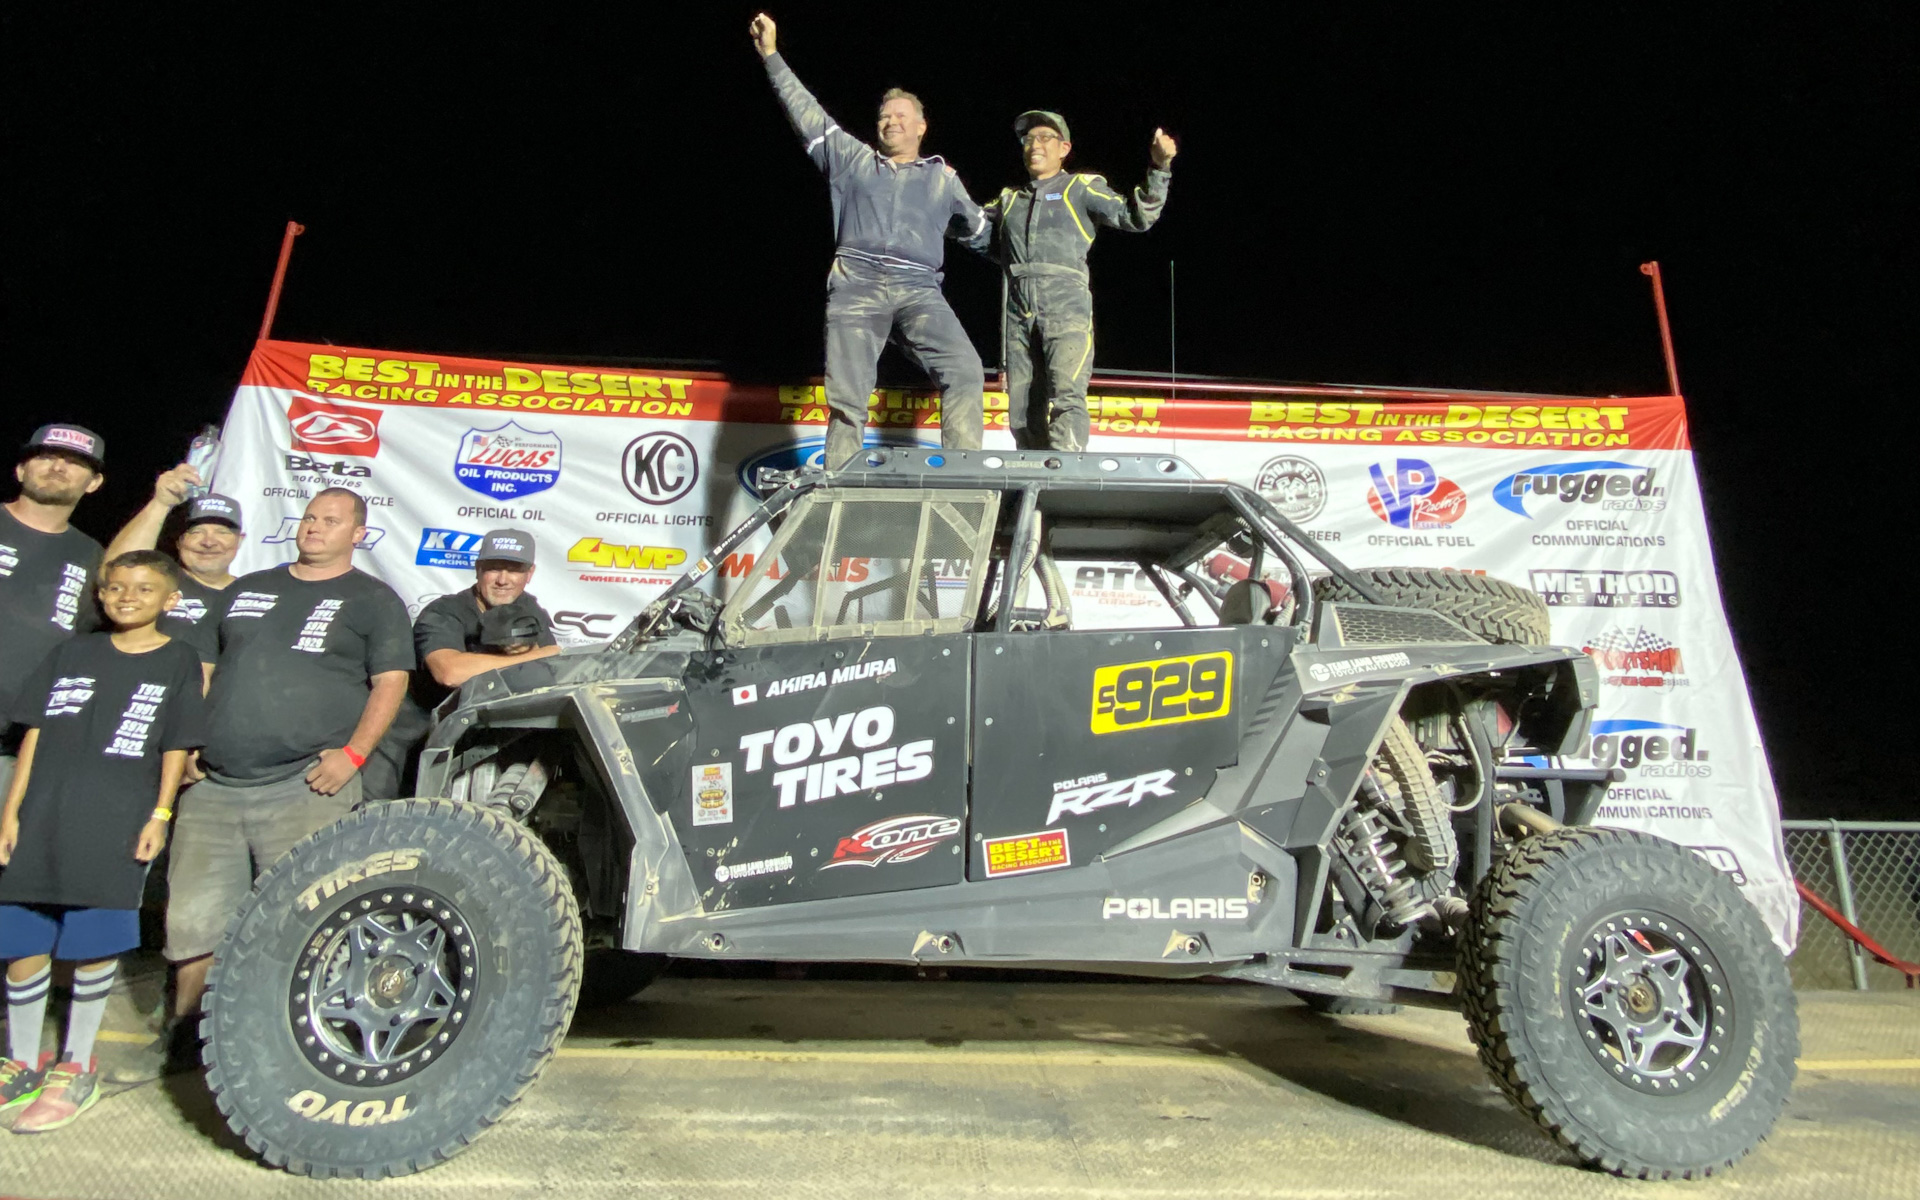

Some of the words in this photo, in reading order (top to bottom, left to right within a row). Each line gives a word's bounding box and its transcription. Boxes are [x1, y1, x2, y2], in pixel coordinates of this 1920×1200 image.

[309, 354, 440, 387] BEST
[436, 373, 459, 388] IN
[463, 375, 503, 391] THE
[503, 367, 693, 399] DESERT
[306, 379, 439, 402] RACING
[448, 392, 694, 416] ASSOCIATION
[1249, 401, 1384, 425] BEST
[1376, 413, 1399, 426] IN
[1405, 414, 1443, 428] THE
[1444, 405, 1628, 430] DESERT
[1247, 425, 1382, 441] RACING
[1395, 430, 1629, 447] ASSOCIATION
[285, 454, 371, 478] Beta
[467, 448, 555, 468] LUCAS
[458, 467, 480, 478] OIL
[485, 469, 553, 484] PRODUCTS
[634, 439, 684, 496] KC
[263, 487, 310, 500] OFFICIAL
[491, 482, 517, 493] INC.
[1368, 458, 1436, 529] VP
[457, 506, 517, 519] OFFICIAL
[522, 509, 546, 521] OIL
[1414, 495, 1461, 520] Racing
[595, 512, 659, 525] OFFICIAL
[664, 514, 714, 527] LIGHTS
[1414, 521, 1452, 530] FUELS
[1566, 520, 1628, 531] OFFICIAL
[494, 543, 523, 551] TIRES
[1367, 534, 1433, 547] OFFICIAL
[1437, 536, 1475, 547] FUEL
[1532, 534, 1666, 548] COMMUNICATIONS
[568, 537, 686, 569] 4WP
[429, 558, 468, 566] RACING
[1533, 572, 1677, 594] METHOD
[1597, 595, 1678, 605] WHEELS
[297, 636, 324, 648] S929
[1331, 666, 1365, 678] TOYOTA
[1365, 662, 1388, 672] AUTO
[1388, 658, 1411, 669] BODY
[765, 672, 827, 698] AKIRA
[831, 657, 896, 684] MIURA
[138, 683, 166, 697] T974
[129, 702, 158, 716] T991
[120, 719, 149, 734] S974
[113, 736, 144, 751] S929
[739, 706, 895, 773] TOYO
[772, 739, 934, 808] TIRES
[1640, 762, 1711, 777] radios
[1053, 771, 1108, 793] POLARIS
[1046, 768, 1177, 825] RZR
[1607, 788, 1673, 800] OFFICIAL
[1595, 806, 1712, 819] MMUNICATIONS
[989, 837, 1041, 855] BEST
[1048, 838, 1062, 846] THE
[990, 844, 1063, 865] DESERT
[991, 861, 1018, 871] RACING
[1019, 854, 1065, 867] ASSOCIATION
[297, 848, 426, 911] TIRES
[730, 869, 755, 880] TOYOTA
[756, 866, 774, 875] AUTO
[1102, 896, 1249, 919] POLARIS
[286, 1089, 414, 1126] TOYO
